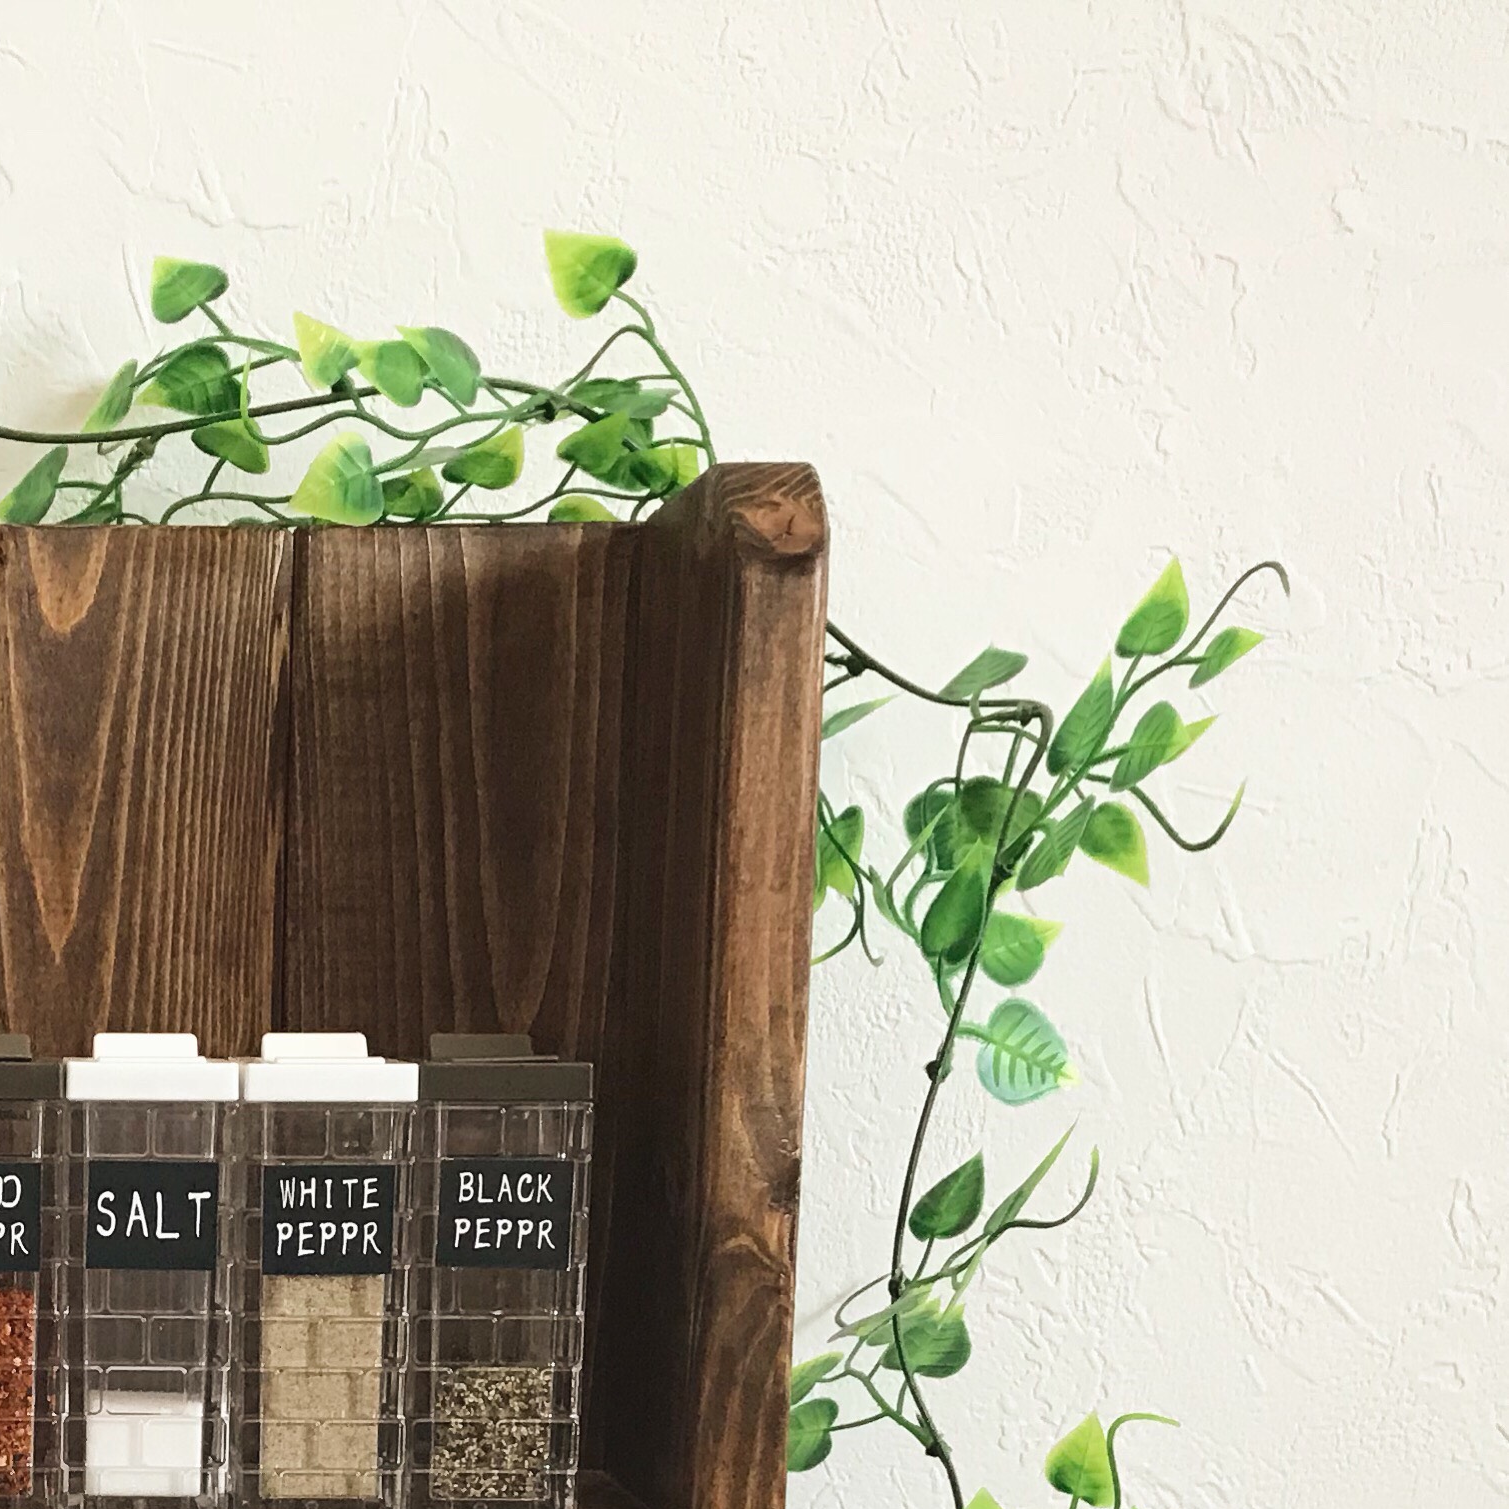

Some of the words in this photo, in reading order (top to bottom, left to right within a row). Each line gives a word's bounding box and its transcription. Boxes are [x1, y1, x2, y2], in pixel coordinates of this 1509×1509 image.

[279, 1176, 380, 1210] WHITE
[458, 1171, 554, 1204] BLACK
[95, 1190, 212, 1240] SALT
[276, 1221, 382, 1257] PEPPR
[453, 1217, 556, 1250] PEPPR
